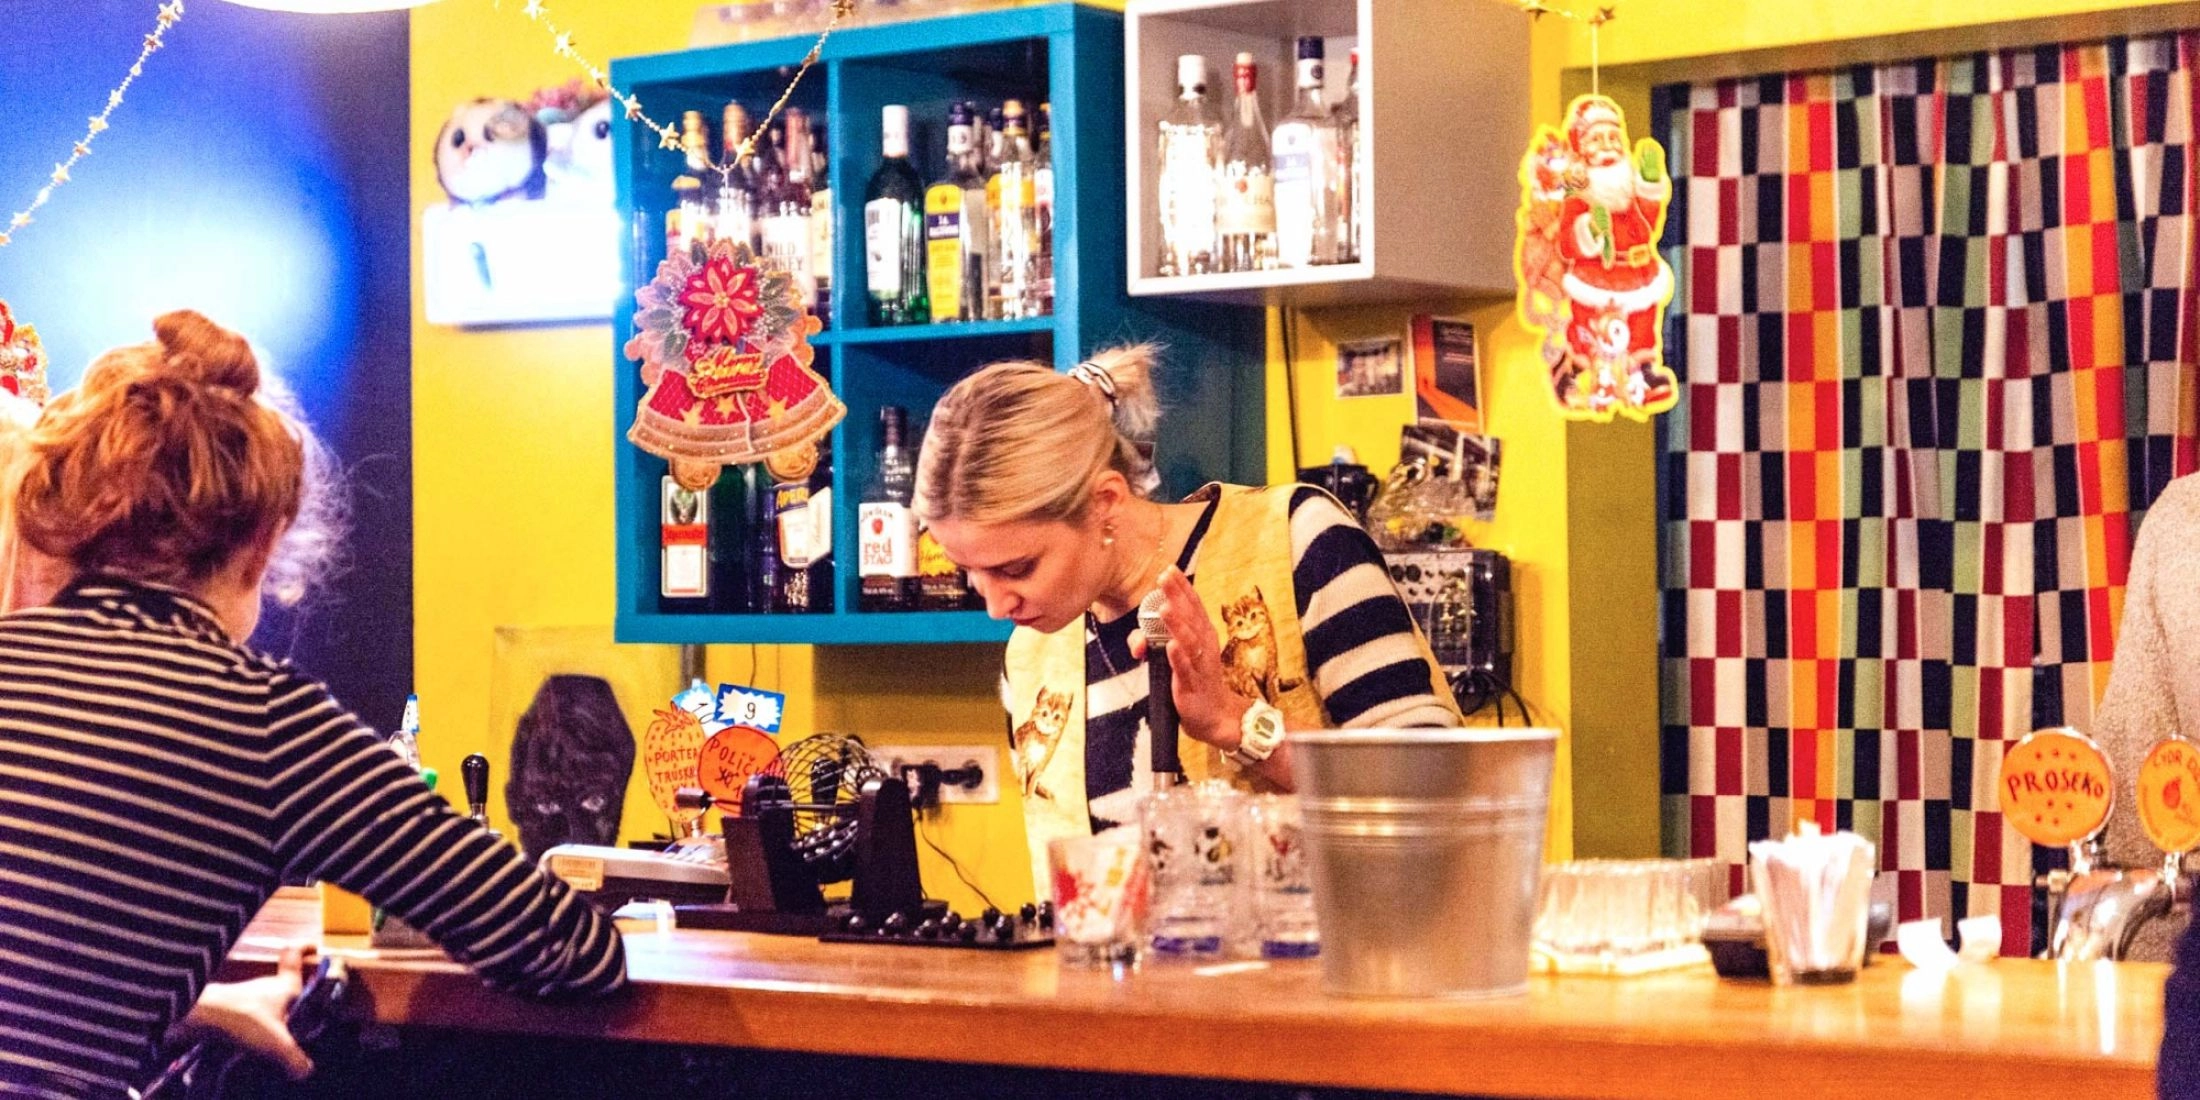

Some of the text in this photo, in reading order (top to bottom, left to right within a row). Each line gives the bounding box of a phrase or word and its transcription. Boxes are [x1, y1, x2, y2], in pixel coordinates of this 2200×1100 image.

[864, 538, 892, 554] red
[863, 553, 893, 565] STAG
[744, 702, 757, 720] 9
[2007, 768, 2104, 802] PROSEKO
